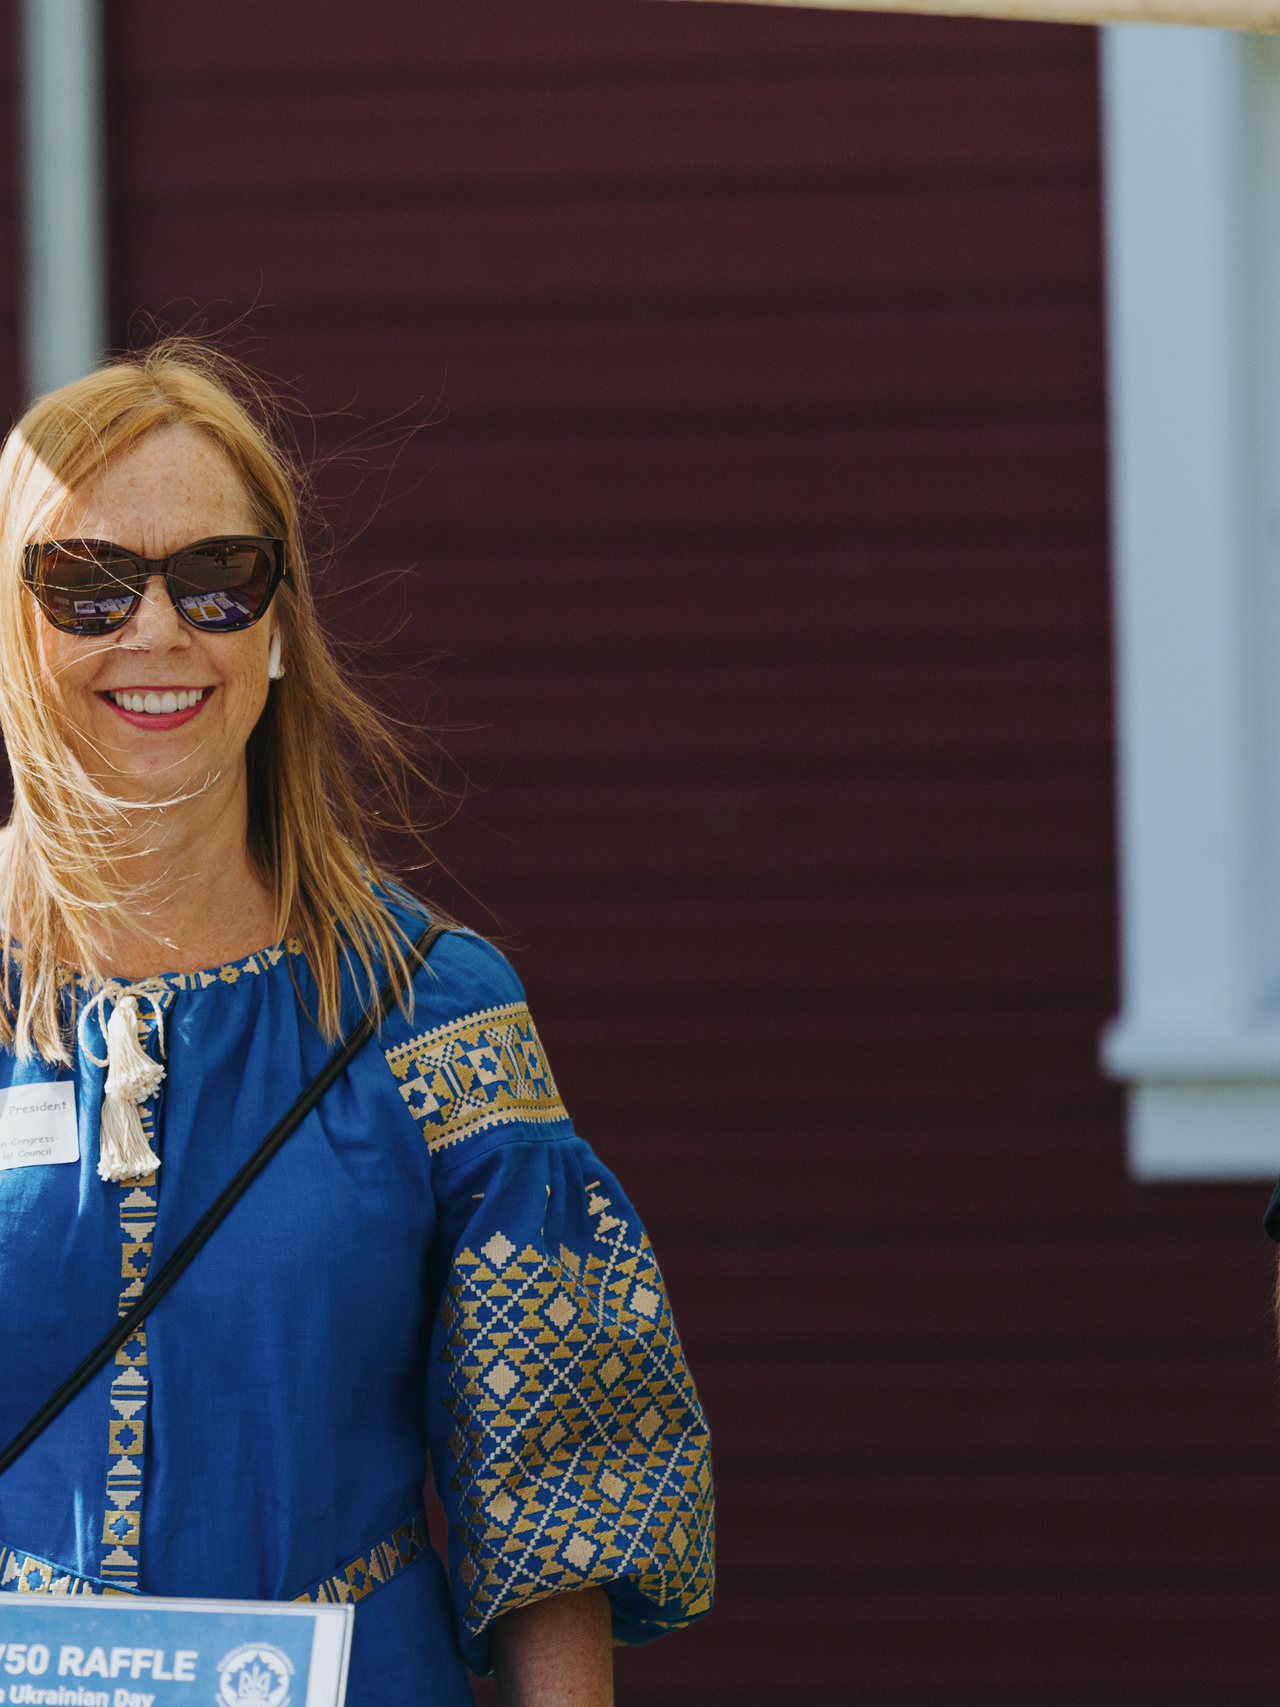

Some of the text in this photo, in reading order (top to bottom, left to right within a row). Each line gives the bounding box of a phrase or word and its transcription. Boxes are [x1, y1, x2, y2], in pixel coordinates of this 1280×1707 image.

[9, 1101, 67, 1115] President
[18, 1147, 52, 1158] Council
[57, 1645, 200, 1682] RAFFLE
[9, 1683, 110, 1707] Ukrainian
[113, 1687, 156, 1707] Day
